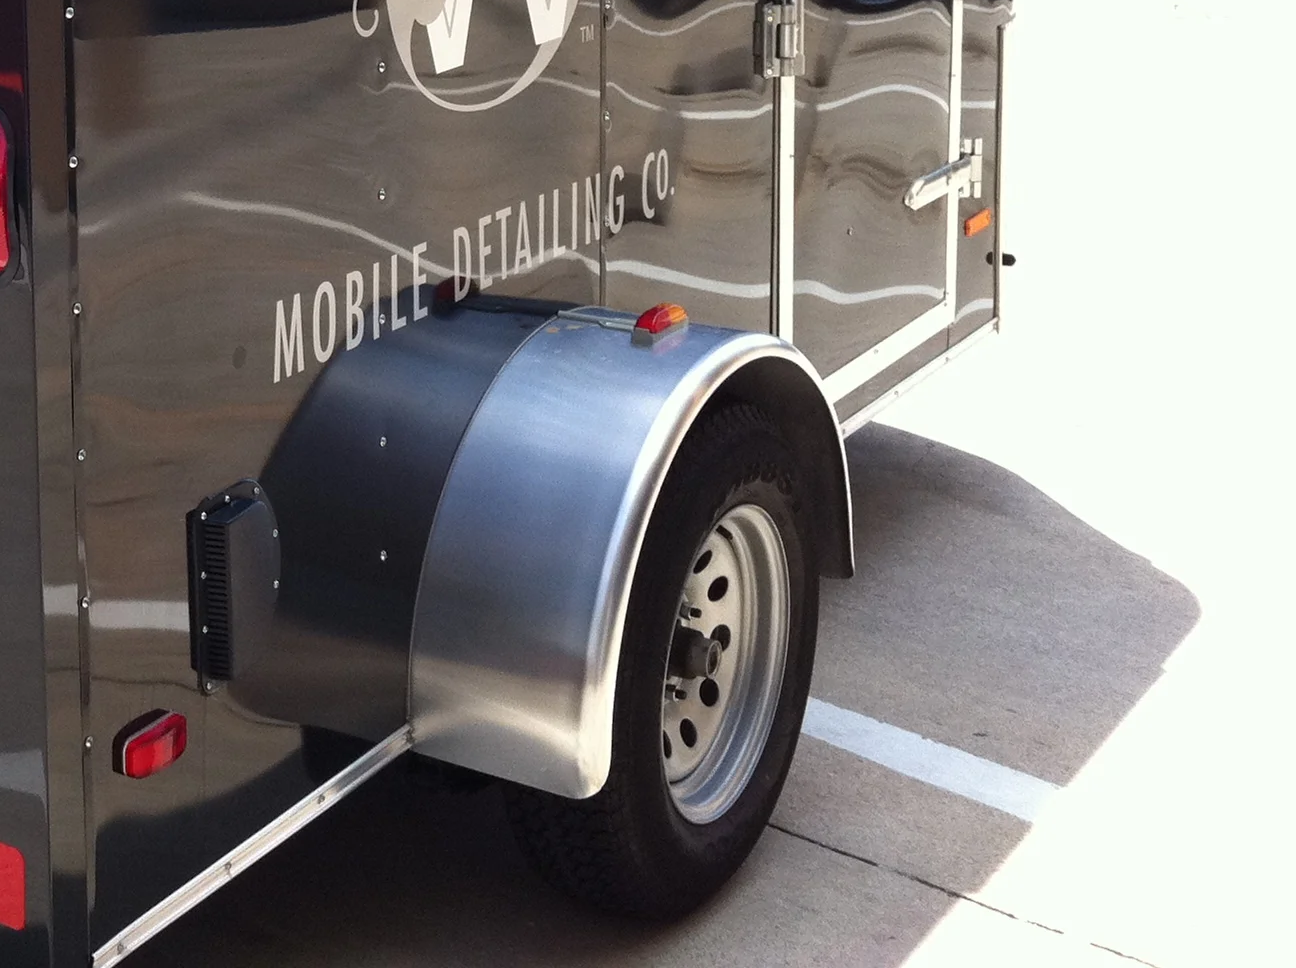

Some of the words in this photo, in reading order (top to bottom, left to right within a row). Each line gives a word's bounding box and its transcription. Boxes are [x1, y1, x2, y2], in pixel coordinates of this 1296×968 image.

[580, 23, 595, 44] TM
[273, 241, 430, 384] MOBILE
[453, 164, 625, 303] DETAILING
[641, 148, 676, 220] CO.
